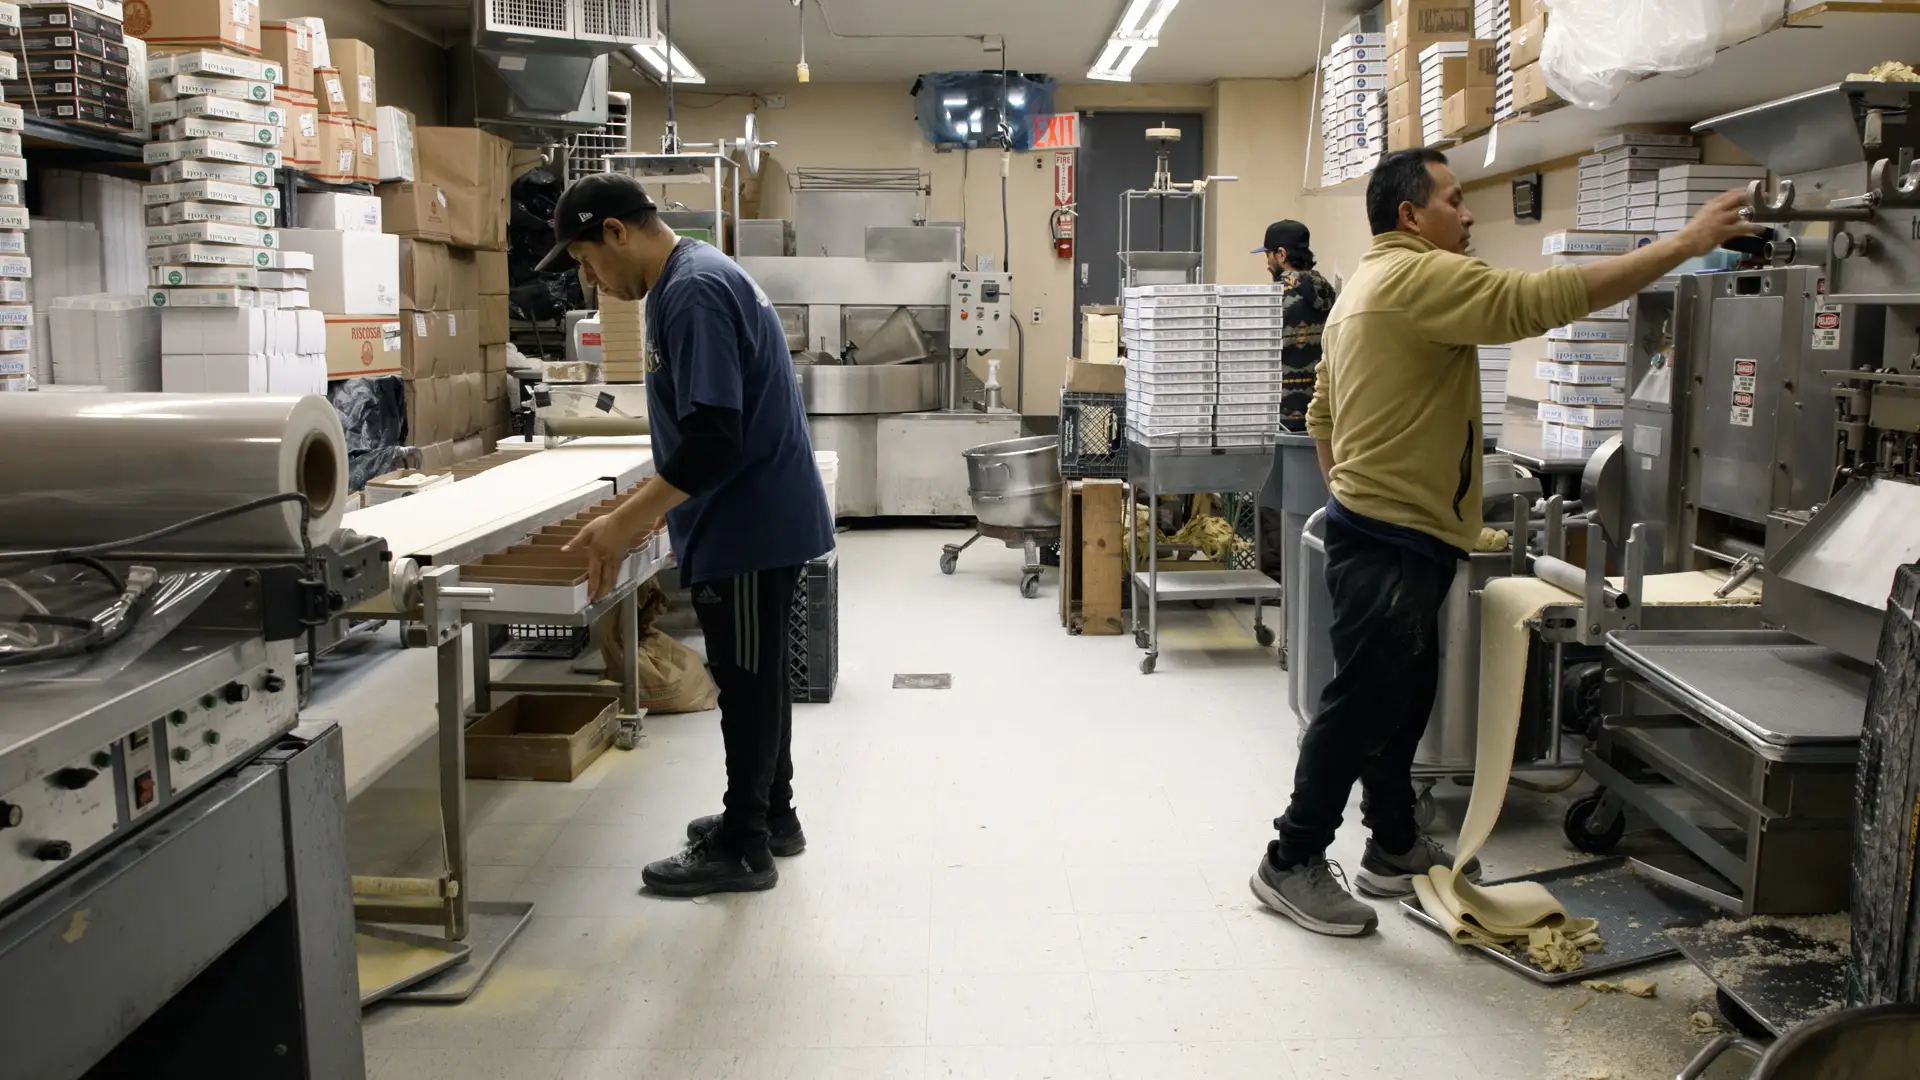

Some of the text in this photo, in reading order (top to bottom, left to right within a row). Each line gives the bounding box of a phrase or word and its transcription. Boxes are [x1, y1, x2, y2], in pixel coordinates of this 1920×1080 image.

[205, 62, 235, 75] Ravioli
[181, 85, 217, 94] Ravioli
[210, 107, 240, 118] Ravioli
[189, 128, 224, 138] Ravioli
[1034, 115, 1075, 147] EXIT
[210, 149, 238, 160] Ravioli
[1056, 156, 1071, 164] FIRE
[187, 170, 221, 179] Ravioli
[210, 191, 238, 201] Ravioli
[188, 212, 221, 221] Ravioli
[210, 233, 237, 242] Ravioli
[1567, 242, 1602, 251] Ravioli
[194, 254, 226, 263] Ravioli
[351, 326, 382, 340] RISCOSSA
[1580, 375, 1613, 383] Ravioli
